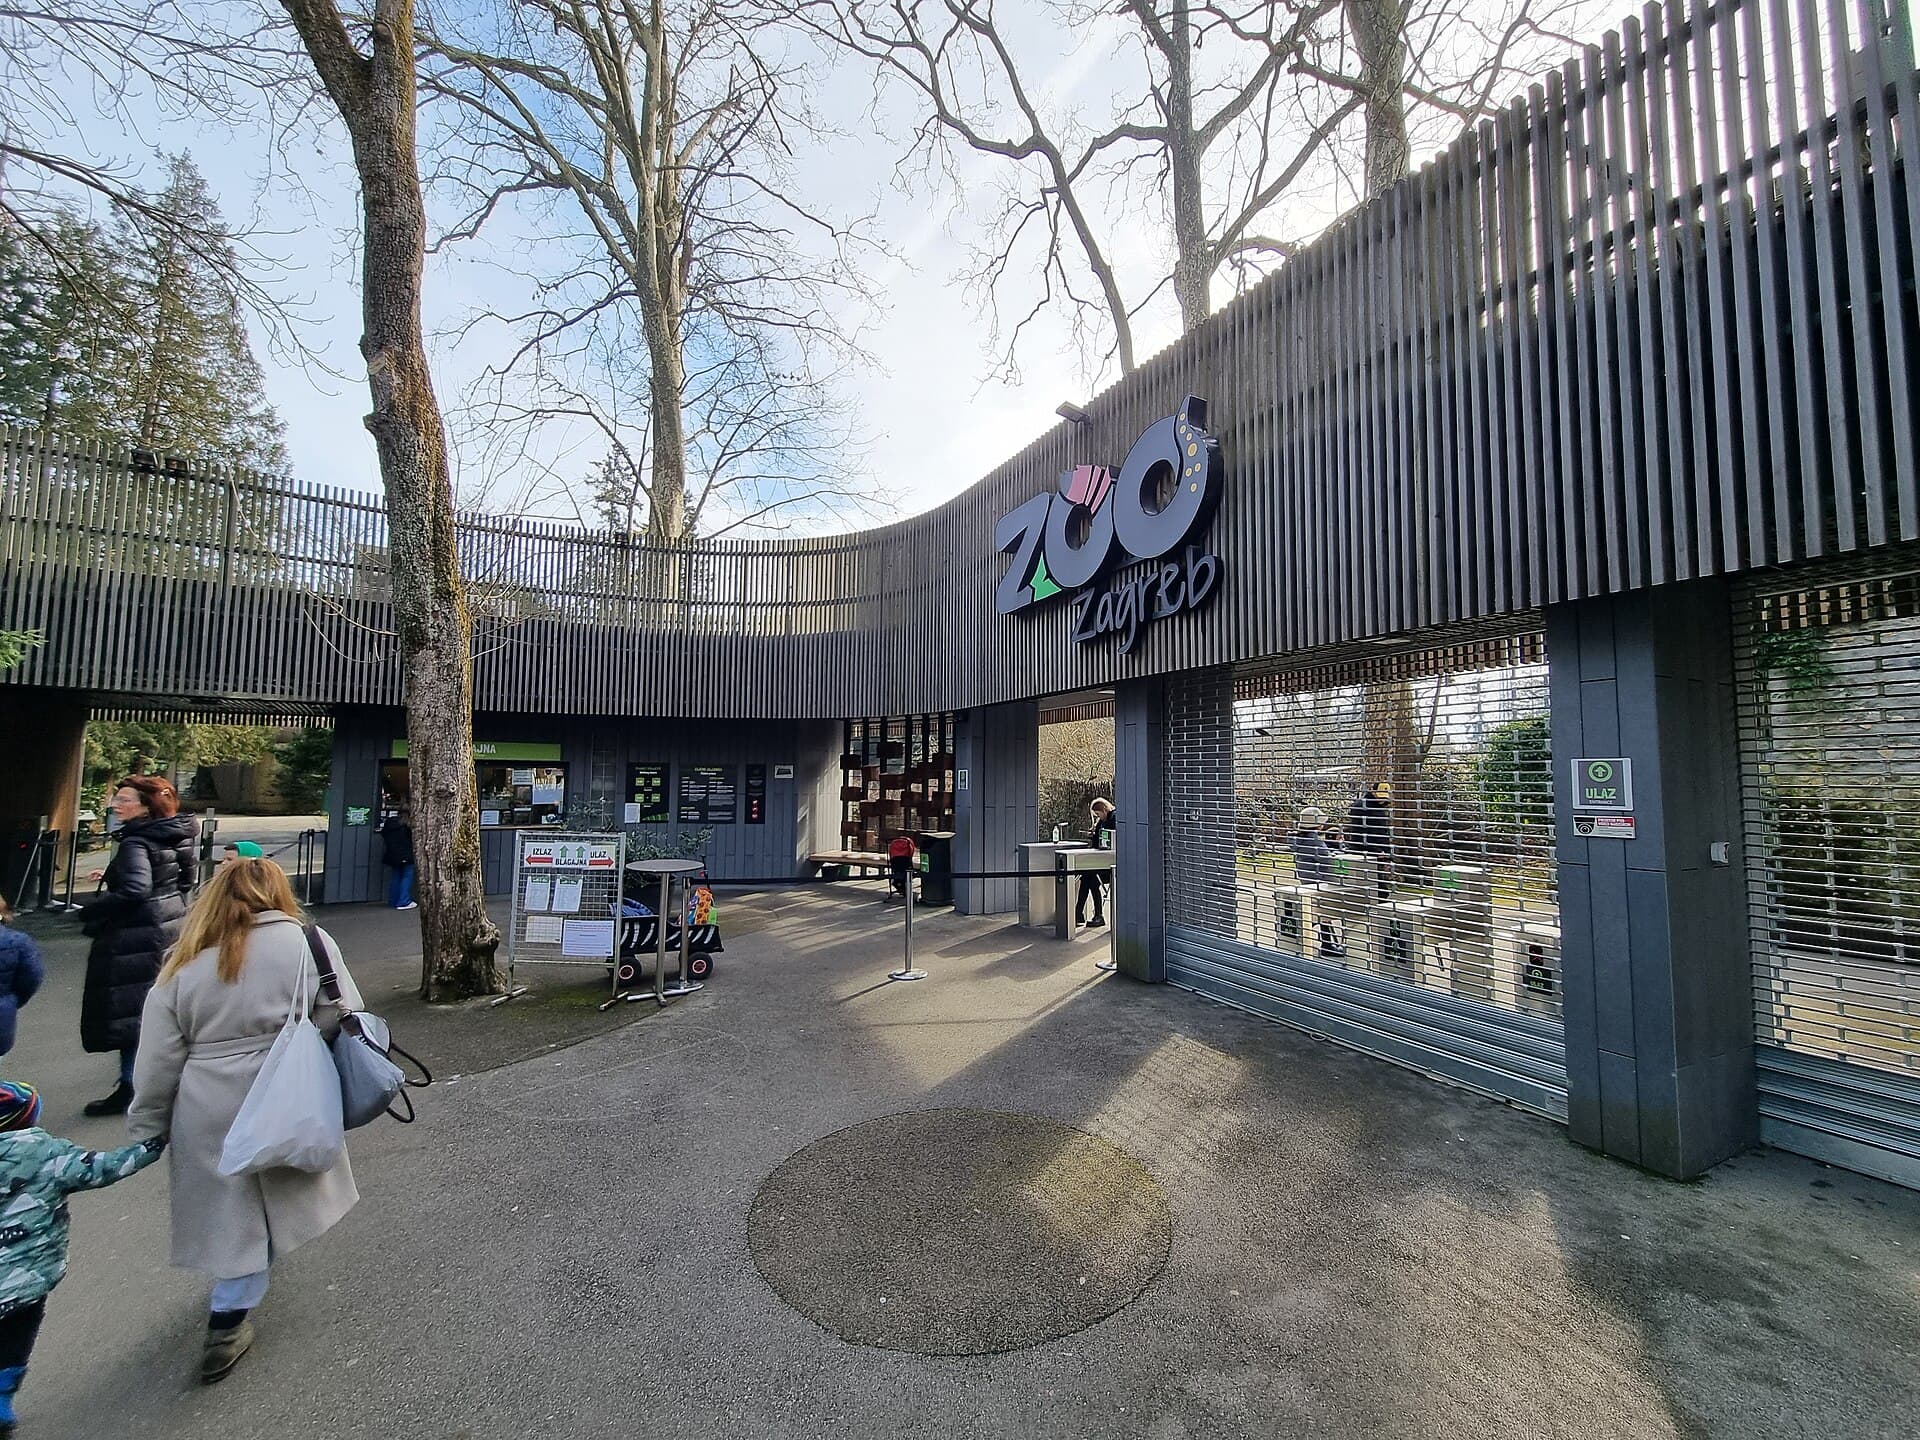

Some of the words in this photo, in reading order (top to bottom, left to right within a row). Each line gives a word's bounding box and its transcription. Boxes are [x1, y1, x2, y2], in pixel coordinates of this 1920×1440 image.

[995, 393, 1213, 615] ZOO
[472, 743, 497, 754] AJNA
[1585, 787, 1617, 800] ULAZ
[532, 847, 553, 856] IZLAZ
[590, 850, 608, 859] ULAZ
[555, 858, 587, 866] BLAGAJNA
